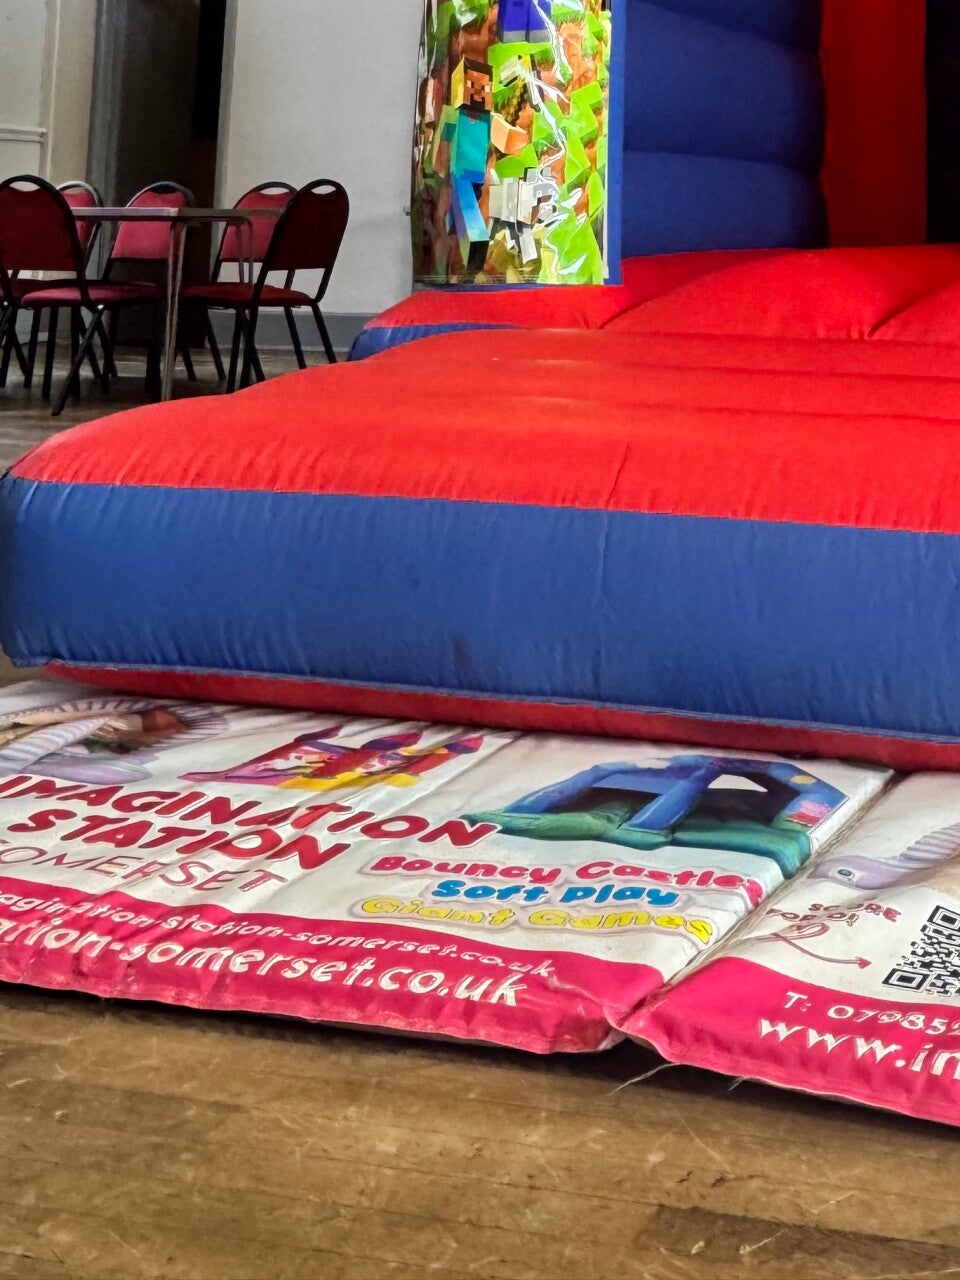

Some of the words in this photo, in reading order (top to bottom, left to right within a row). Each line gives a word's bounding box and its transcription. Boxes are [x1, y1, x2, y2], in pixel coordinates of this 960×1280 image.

[0, 776, 498, 847] IMAGINATION
[0, 838, 288, 892] OMERSET
[7, 808, 351, 870] STATION
[371, 856, 562, 885] Bouncy
[575, 861, 763, 909] Castles
[431, 879, 550, 903] Soft
[559, 884, 681, 907] Play
[0, 891, 556, 978] agination-station-somerset.co.uk
[361, 898, 517, 926] Giant
[528, 910, 714, 946] Games
[783, 991, 810, 1013] T:
